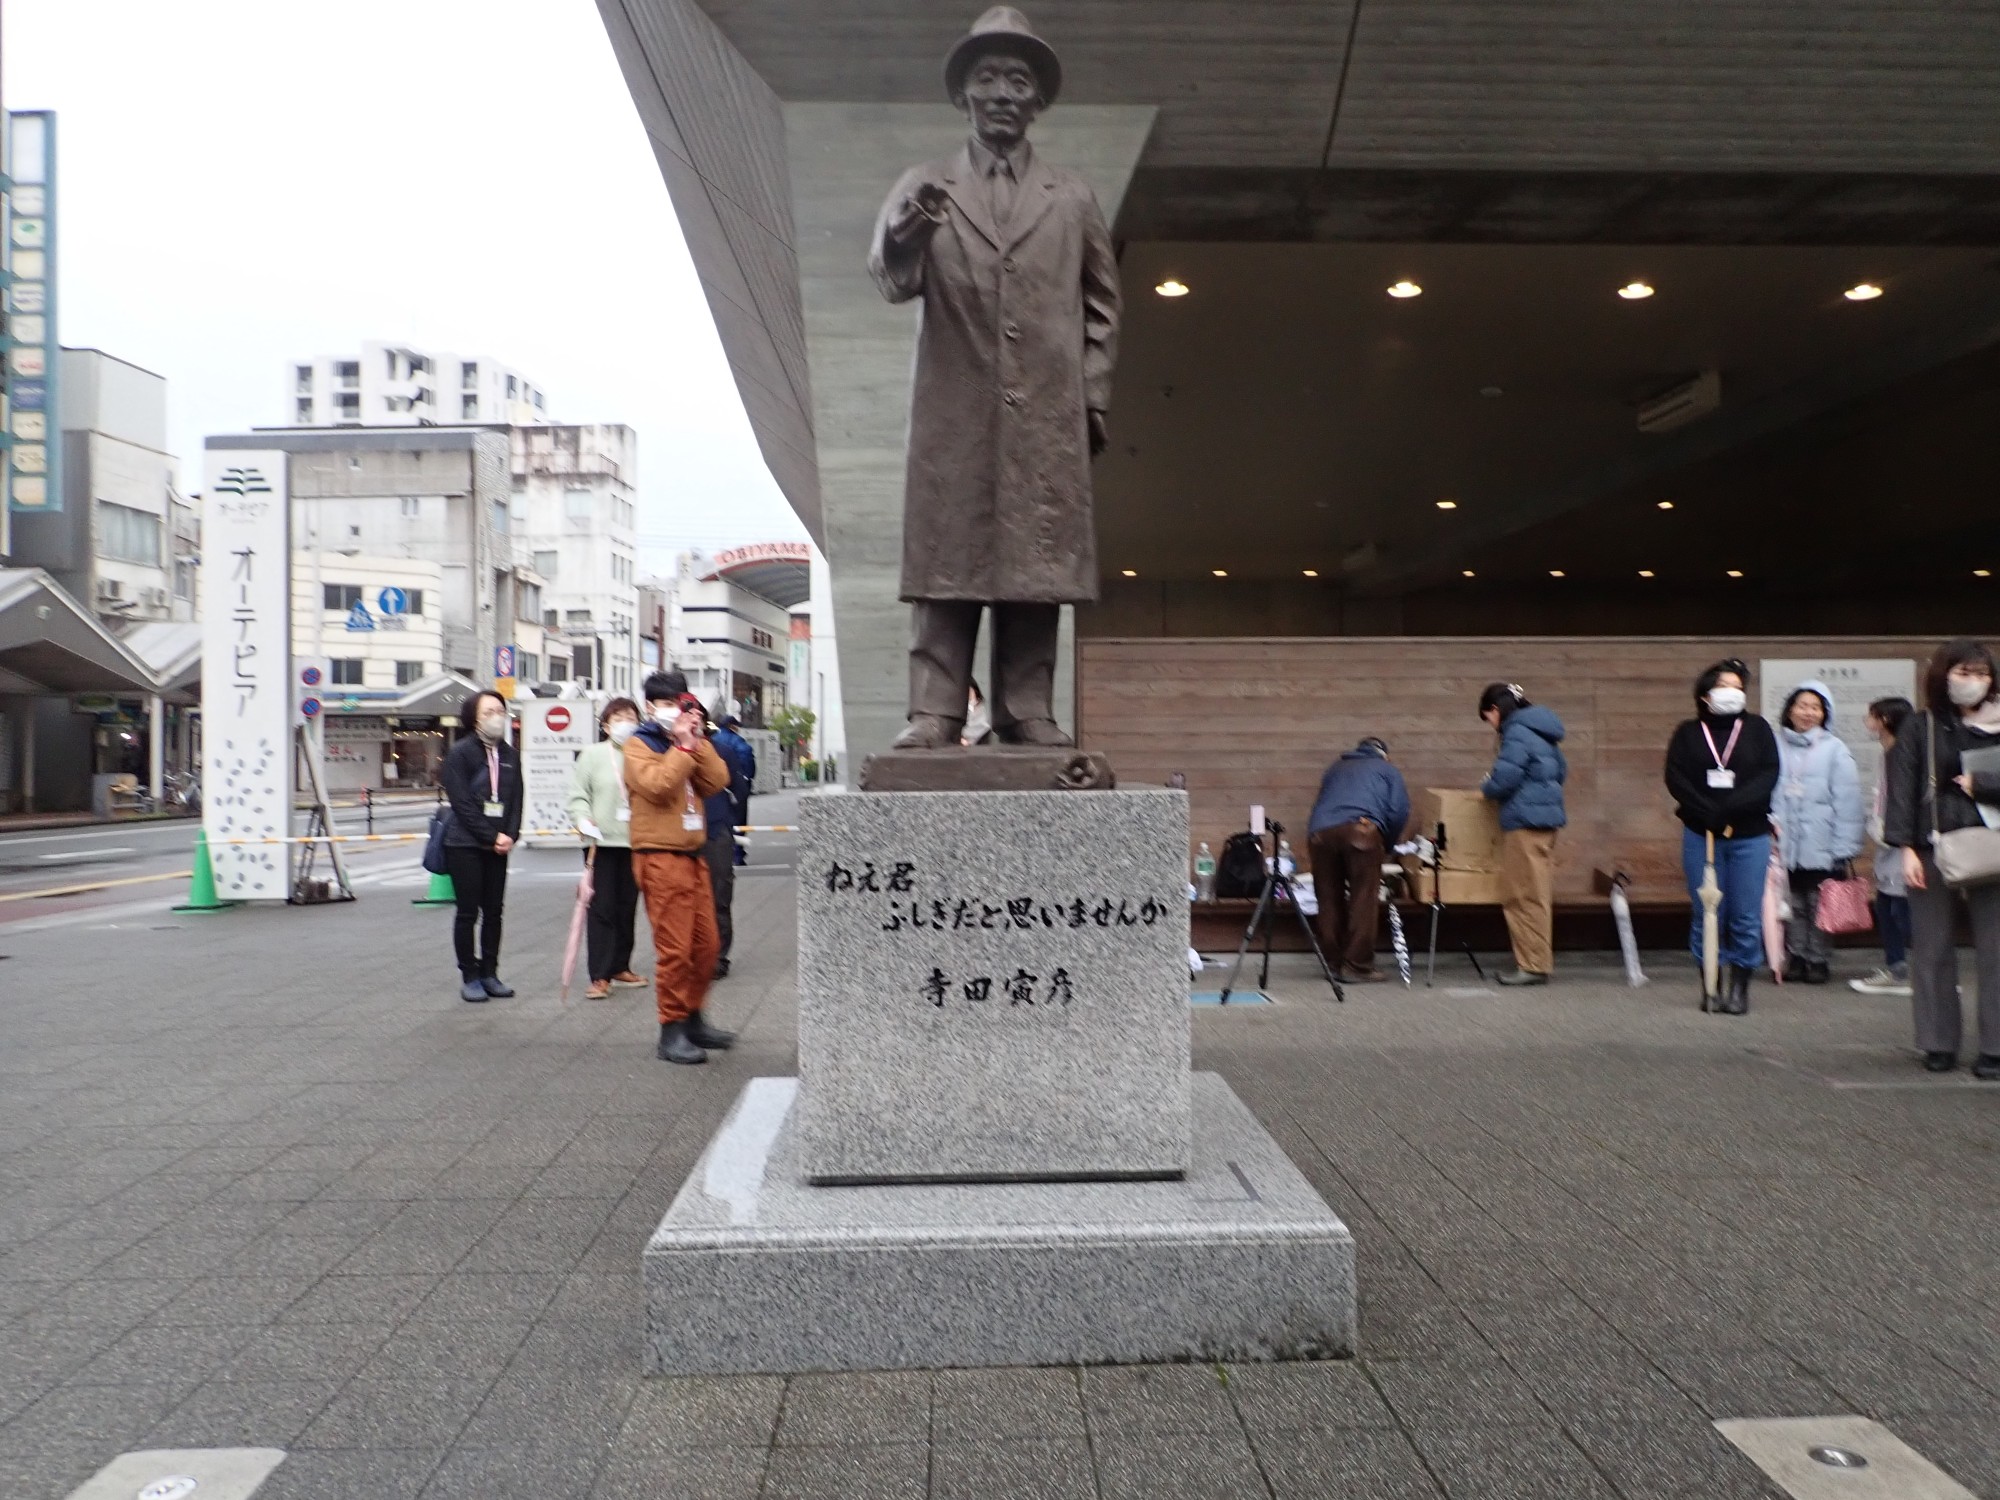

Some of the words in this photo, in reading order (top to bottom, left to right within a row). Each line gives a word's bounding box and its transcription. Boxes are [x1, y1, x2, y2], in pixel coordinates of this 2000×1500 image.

[231, 545, 258, 717] オーテピア
[825, 861, 916, 893] ねえ君
[882, 896, 1168, 931] ふしぎだと思いませんか
[919, 967, 1075, 1008] 寺田寅彦
